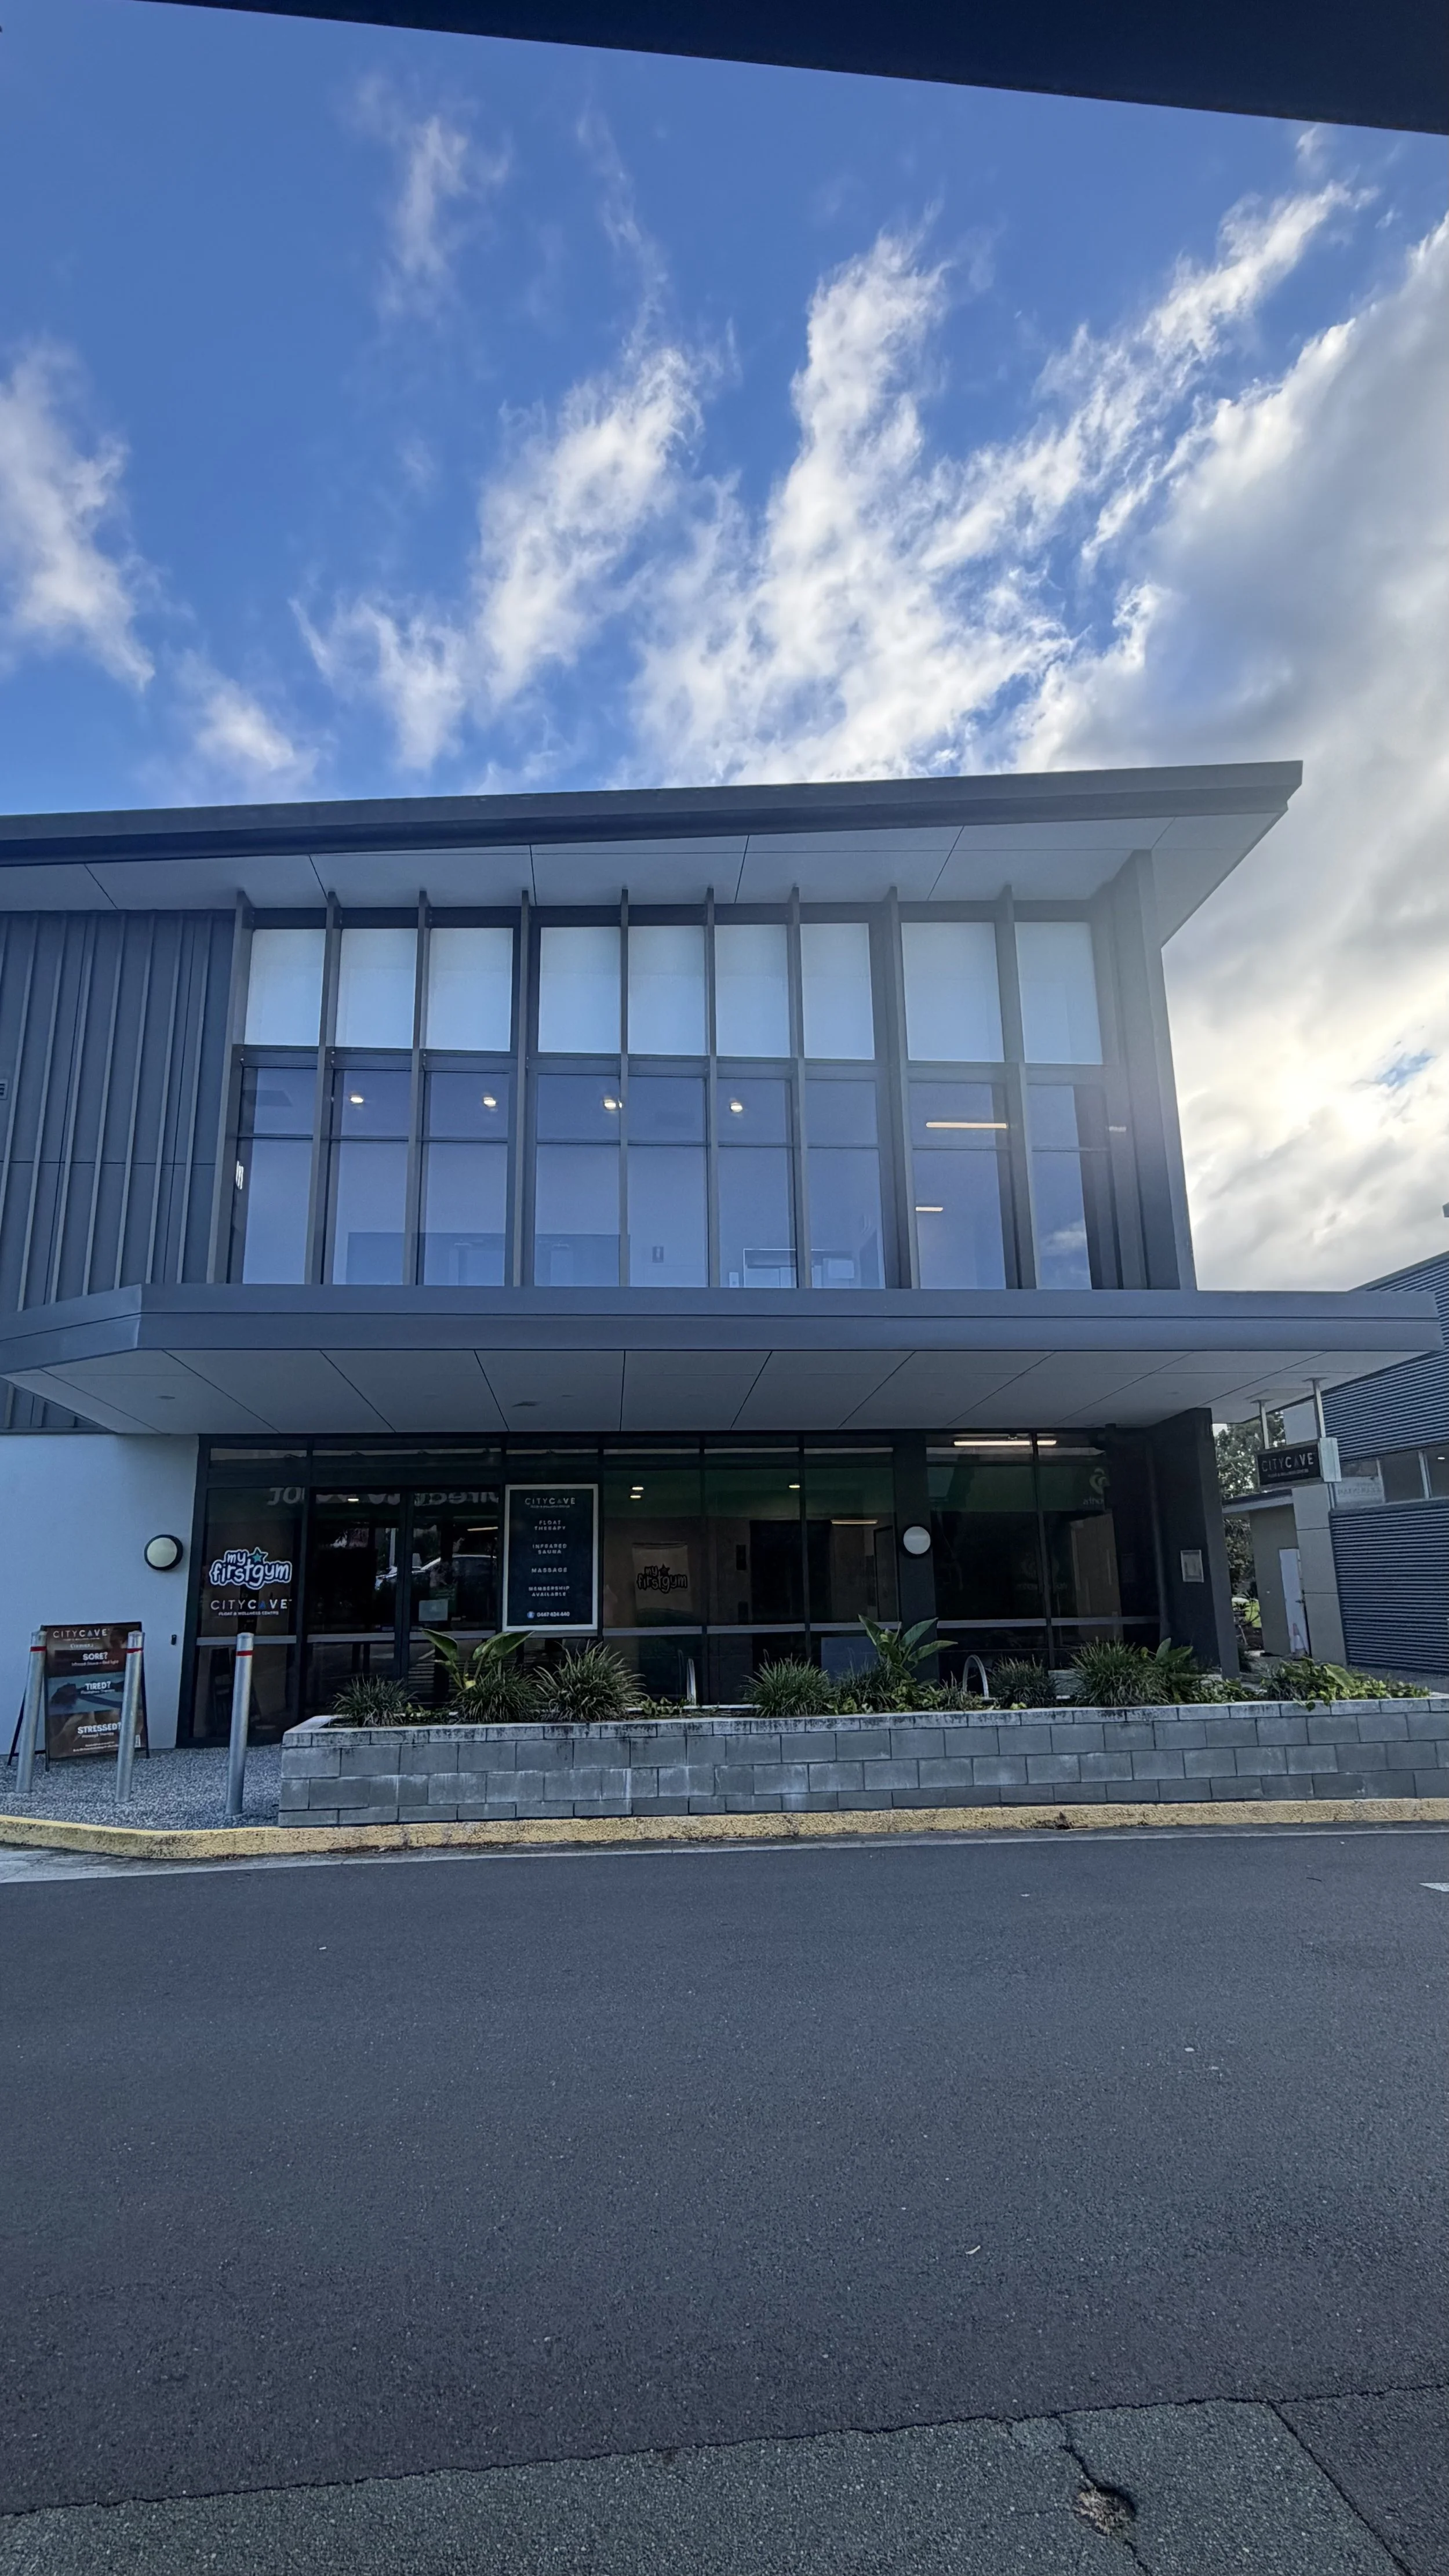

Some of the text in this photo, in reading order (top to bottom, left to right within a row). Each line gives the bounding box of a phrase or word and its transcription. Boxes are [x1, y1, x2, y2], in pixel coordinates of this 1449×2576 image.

[227, 1552, 246, 1566] my
[82, 1652, 108, 1661] SORE?
[85, 1681, 111, 1690] TIRED?
[77, 1722, 121, 1734] STRESSED?
